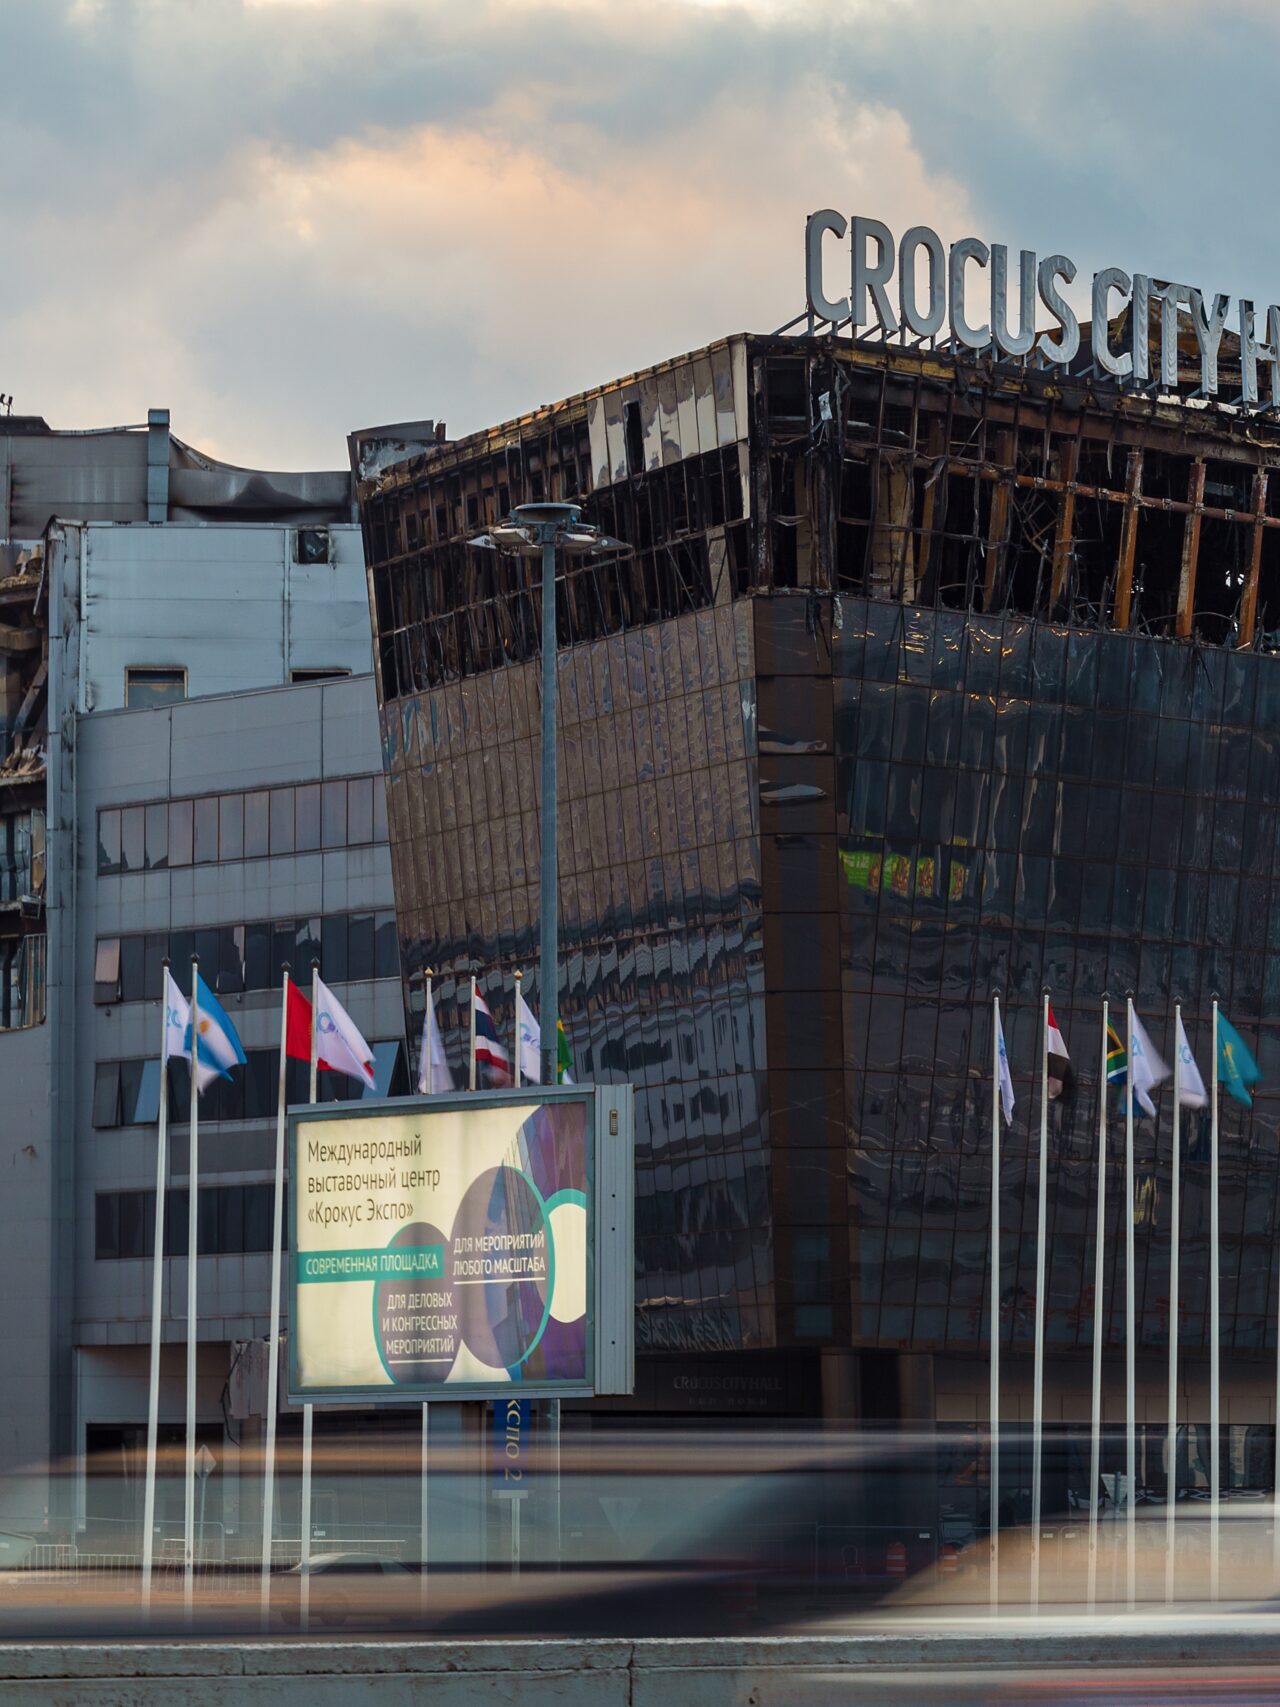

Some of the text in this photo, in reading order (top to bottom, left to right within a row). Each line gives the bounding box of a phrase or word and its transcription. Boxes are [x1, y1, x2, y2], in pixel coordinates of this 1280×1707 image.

[805, 209, 1080, 364] CROCUS
[1092, 267, 1230, 395] CITY
[308, 1134, 422, 1166] Международный
[308, 1167, 440, 1193] выставочный центр
[308, 1199, 414, 1228] «Крокус Экспо»
[453, 1231, 544, 1254] ДЛЯ МЕРОПРИЯТИЙ
[306, 1253, 439, 1275] СОВРЕМЕННАЯ ПЛОЩАДКА
[453, 1257, 546, 1277] ЛЮБОГО МАСШТАБА
[387, 1292, 453, 1311] ДЛЯ ДЕЛОВЫХ
[383, 1315, 458, 1332] И КОНГРЕССНЫХ
[386, 1335, 454, 1355] МЕРОПРИЯТИЙ
[505, 1467, 522, 1480] 2
